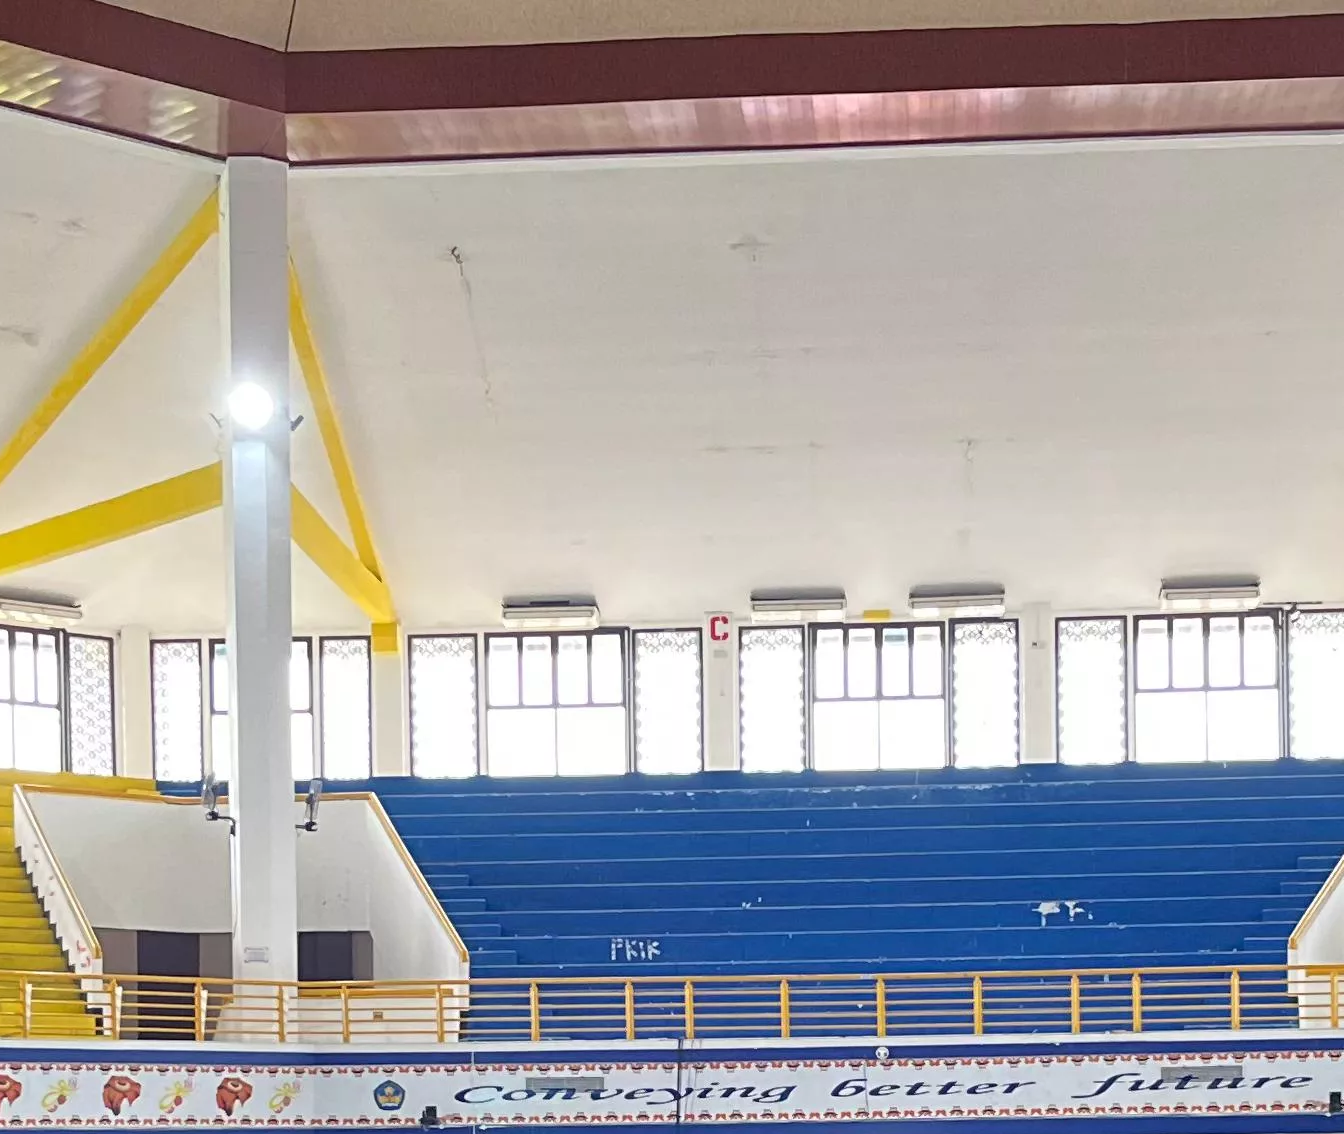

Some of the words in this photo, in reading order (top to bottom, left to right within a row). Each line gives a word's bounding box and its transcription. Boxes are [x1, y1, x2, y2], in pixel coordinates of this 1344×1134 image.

[710, 616, 729, 641] C
[454, 1082, 798, 1105] Conveying
[830, 1078, 1036, 1098] better
[1071, 1073, 1313, 1099] future
